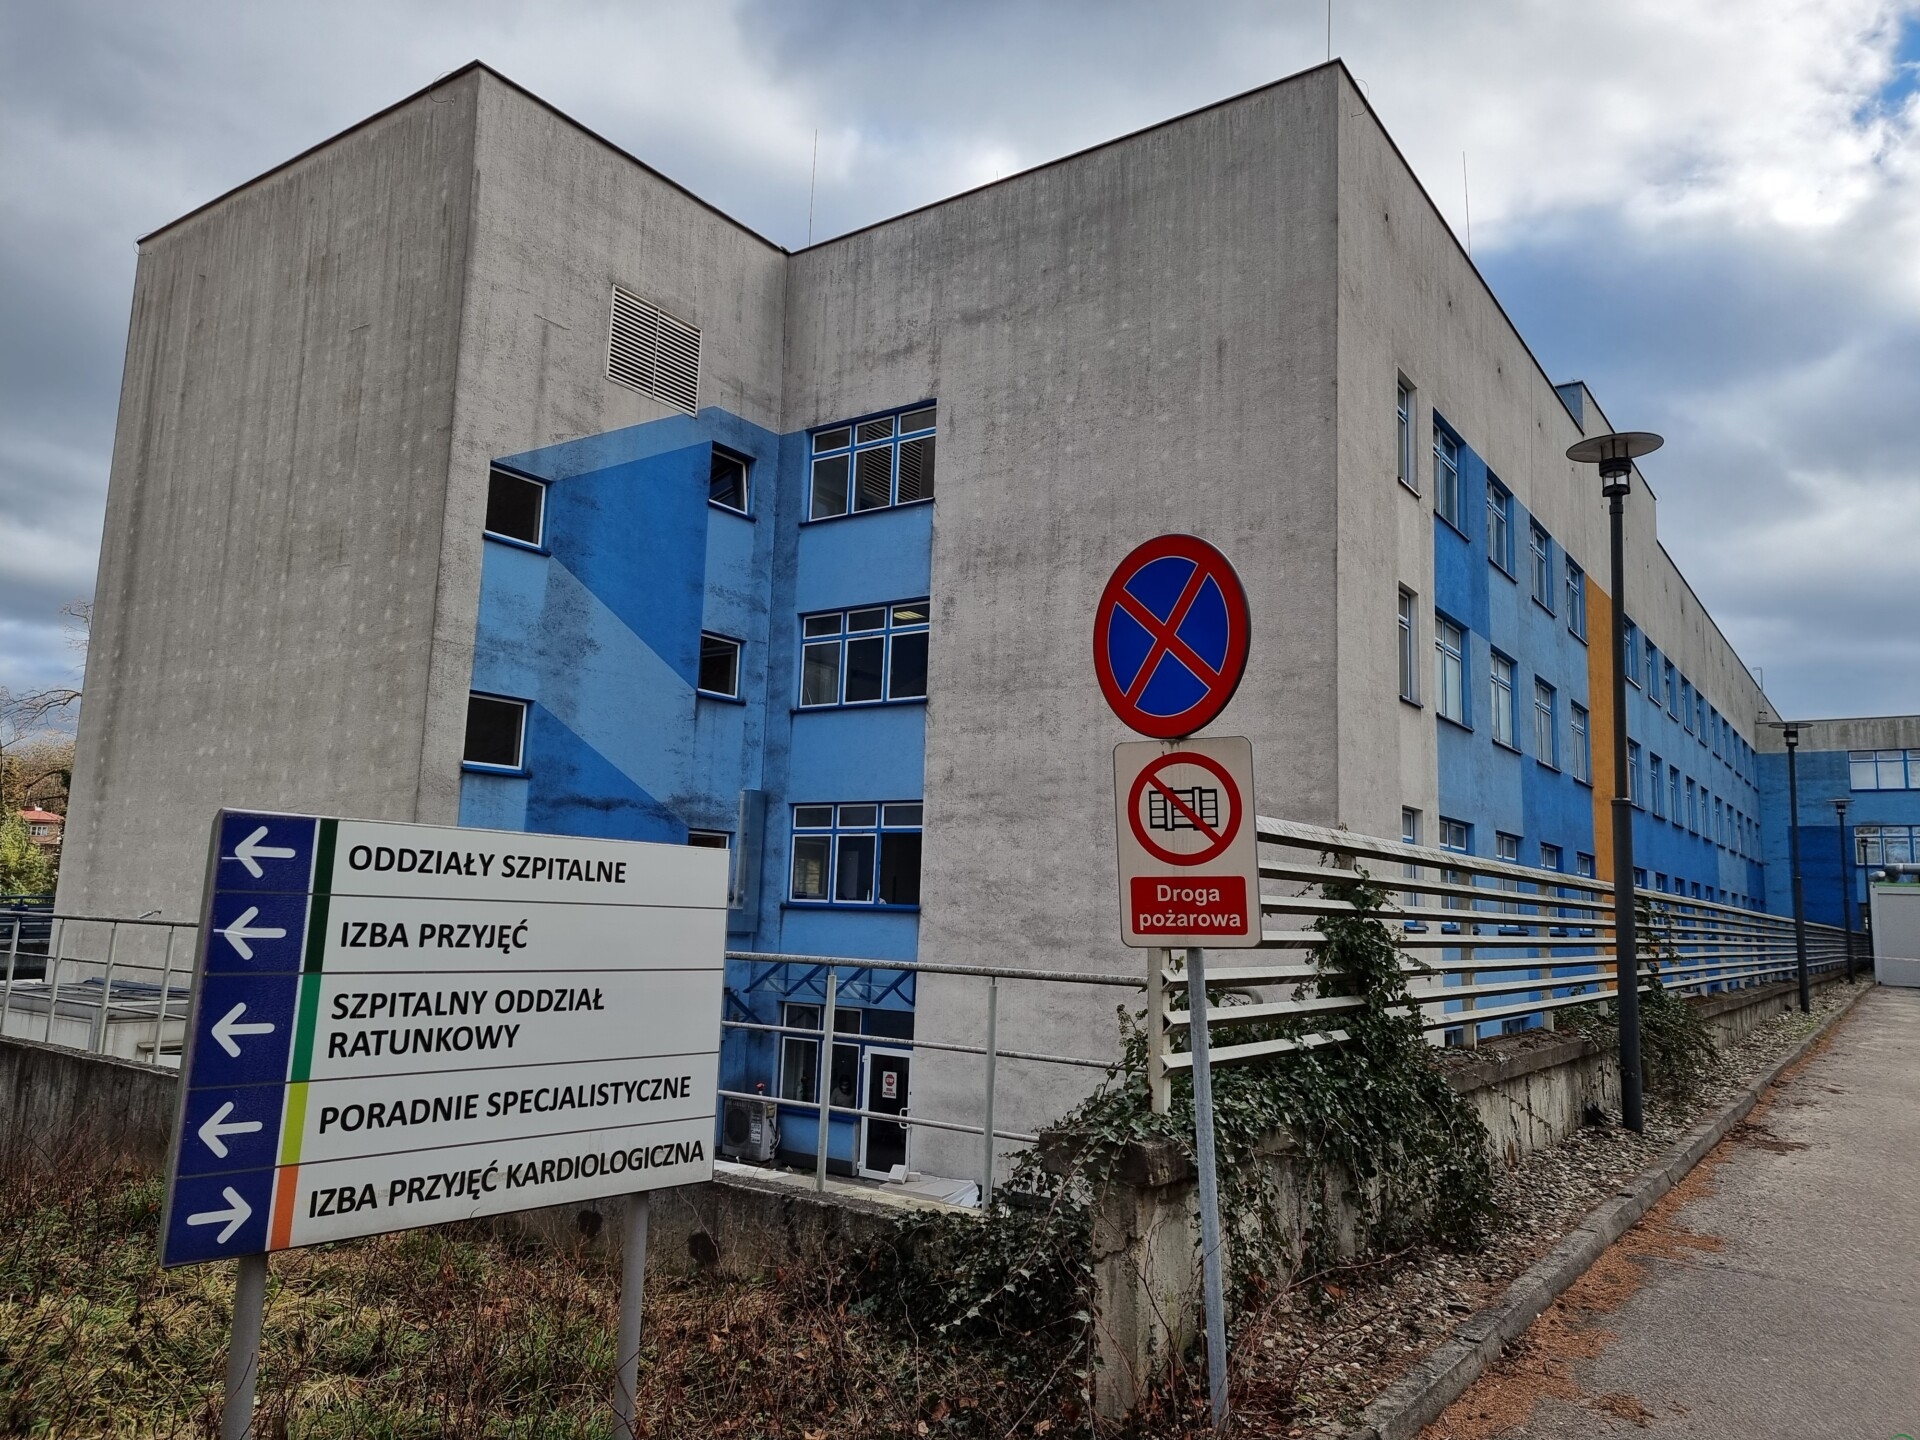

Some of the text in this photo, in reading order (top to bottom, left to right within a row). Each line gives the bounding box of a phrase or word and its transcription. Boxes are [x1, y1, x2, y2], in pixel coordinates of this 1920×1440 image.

[348, 844, 627, 884] ODDZIAŁY SZPITALNE
[1156, 884, 1220, 906] Droga
[340, 919, 529, 955] IZBA PRZYJĘĆ
[1139, 909, 1241, 931] pożarowa
[331, 987, 605, 1021] SZPITALNY ODDZIAŁ
[327, 1023, 521, 1059] RATUNKOWY
[319, 1075, 692, 1135] PORADNIE SPECJALISTYCZNE
[308, 1140, 705, 1219] IZBA PRZYJĘĆ KARDIOLOGICZNA
